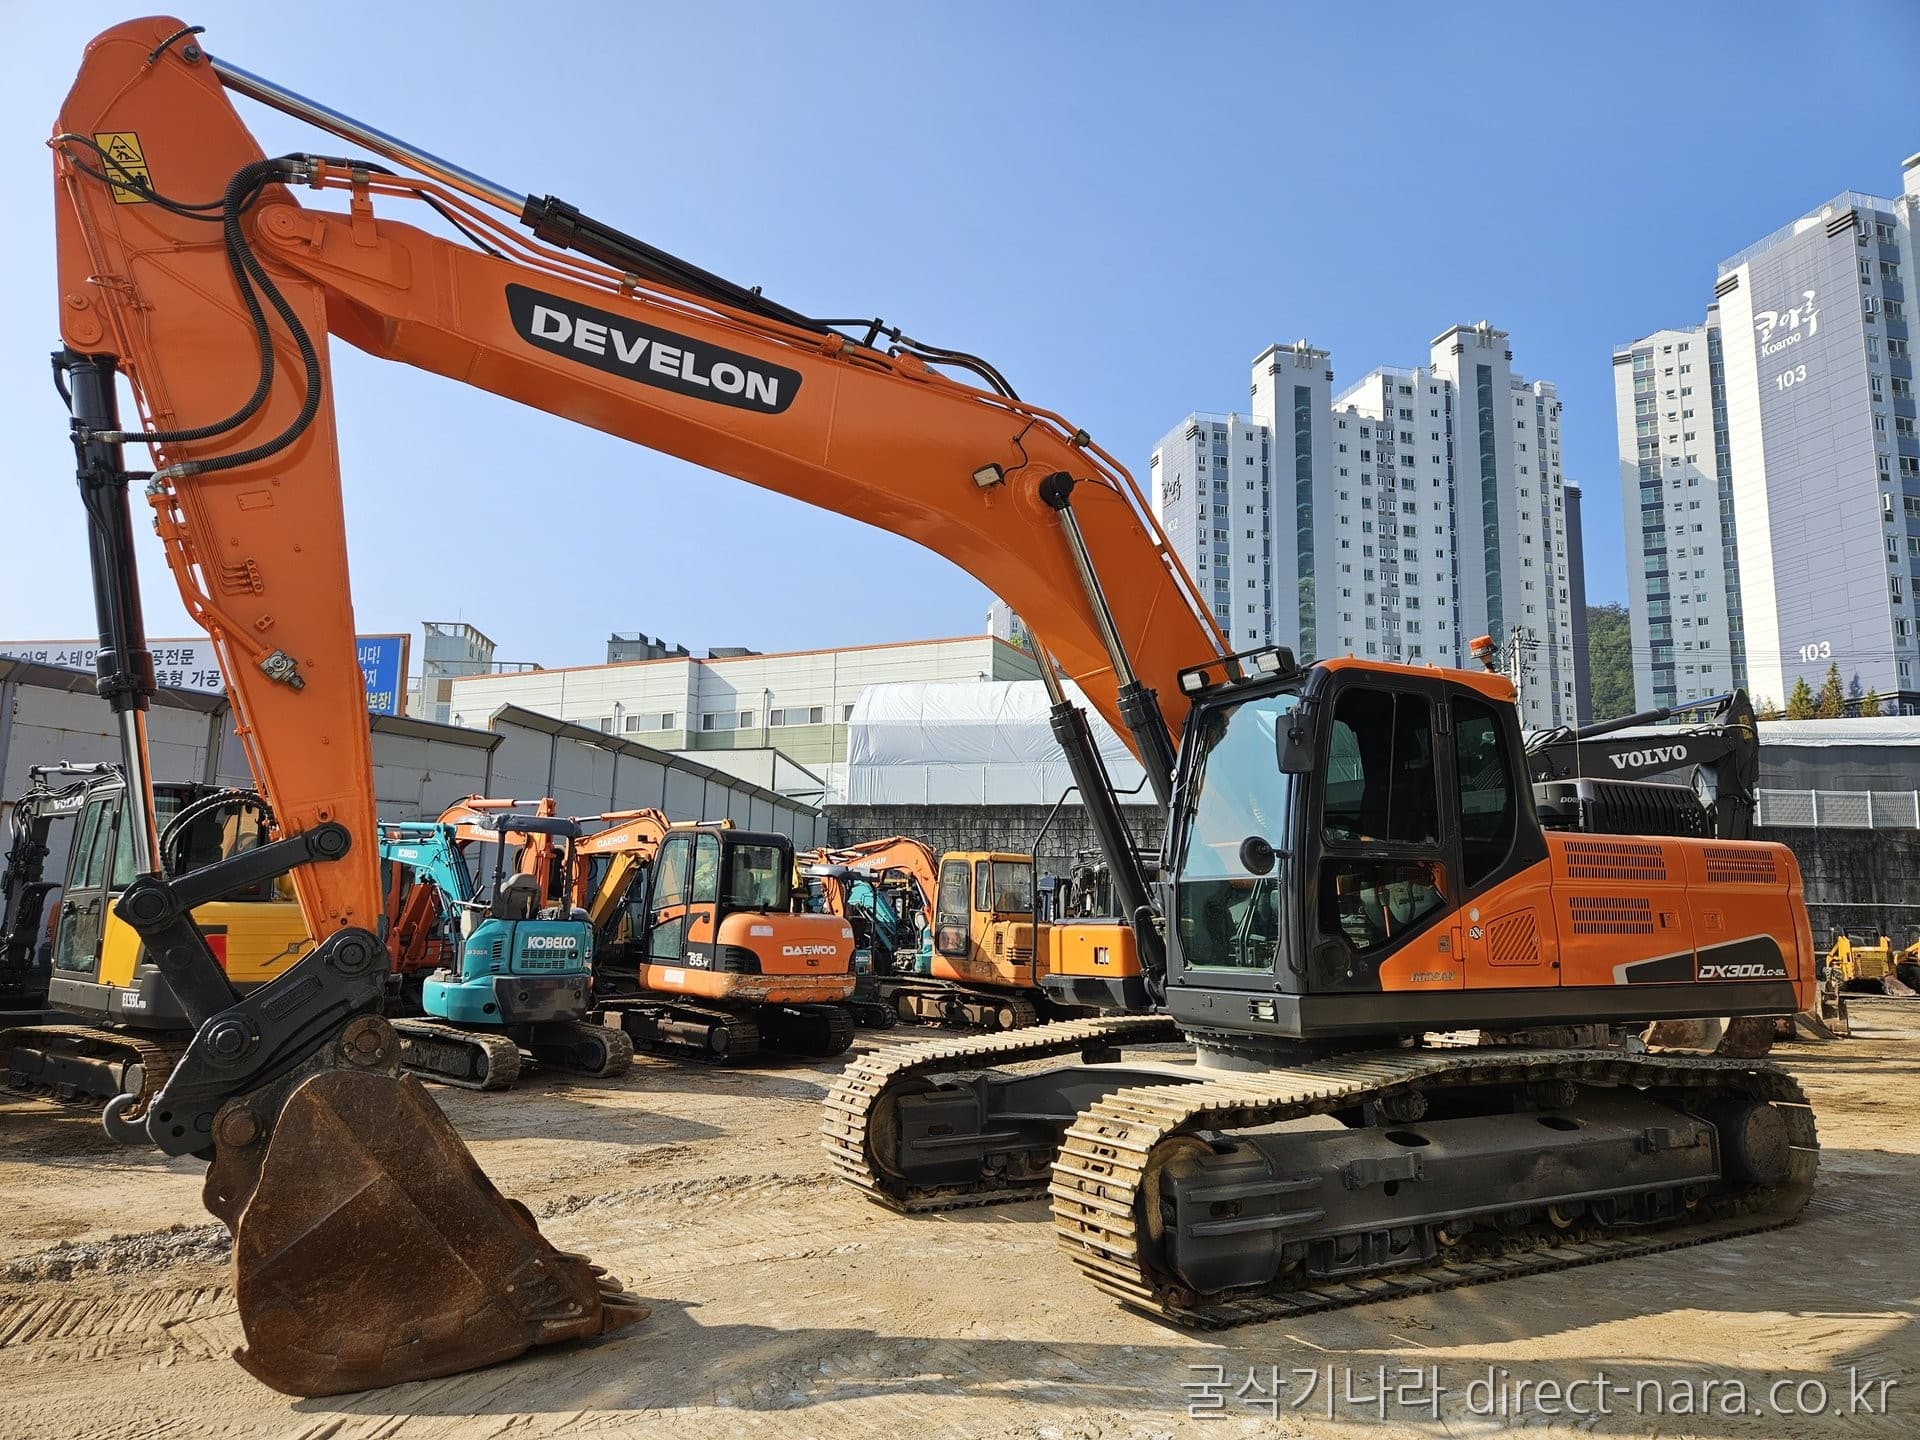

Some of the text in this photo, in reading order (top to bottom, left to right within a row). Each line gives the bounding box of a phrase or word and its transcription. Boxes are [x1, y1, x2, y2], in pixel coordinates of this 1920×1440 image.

[1761, 332, 1802, 358] Koaroo
[531, 304, 779, 407] DEVELON
[1775, 364, 1807, 391] 103
[1799, 640, 1831, 663] 103
[191, 670, 221, 687] 가공
[366, 691, 392, 710] 보장!
[1608, 744, 1688, 770] VOLVO
[53, 795, 84, 810] VOLVO
[597, 834, 629, 848] DAEWOO
[527, 936, 577, 949] KOBELCO
[782, 945, 837, 956] DAEWOO
